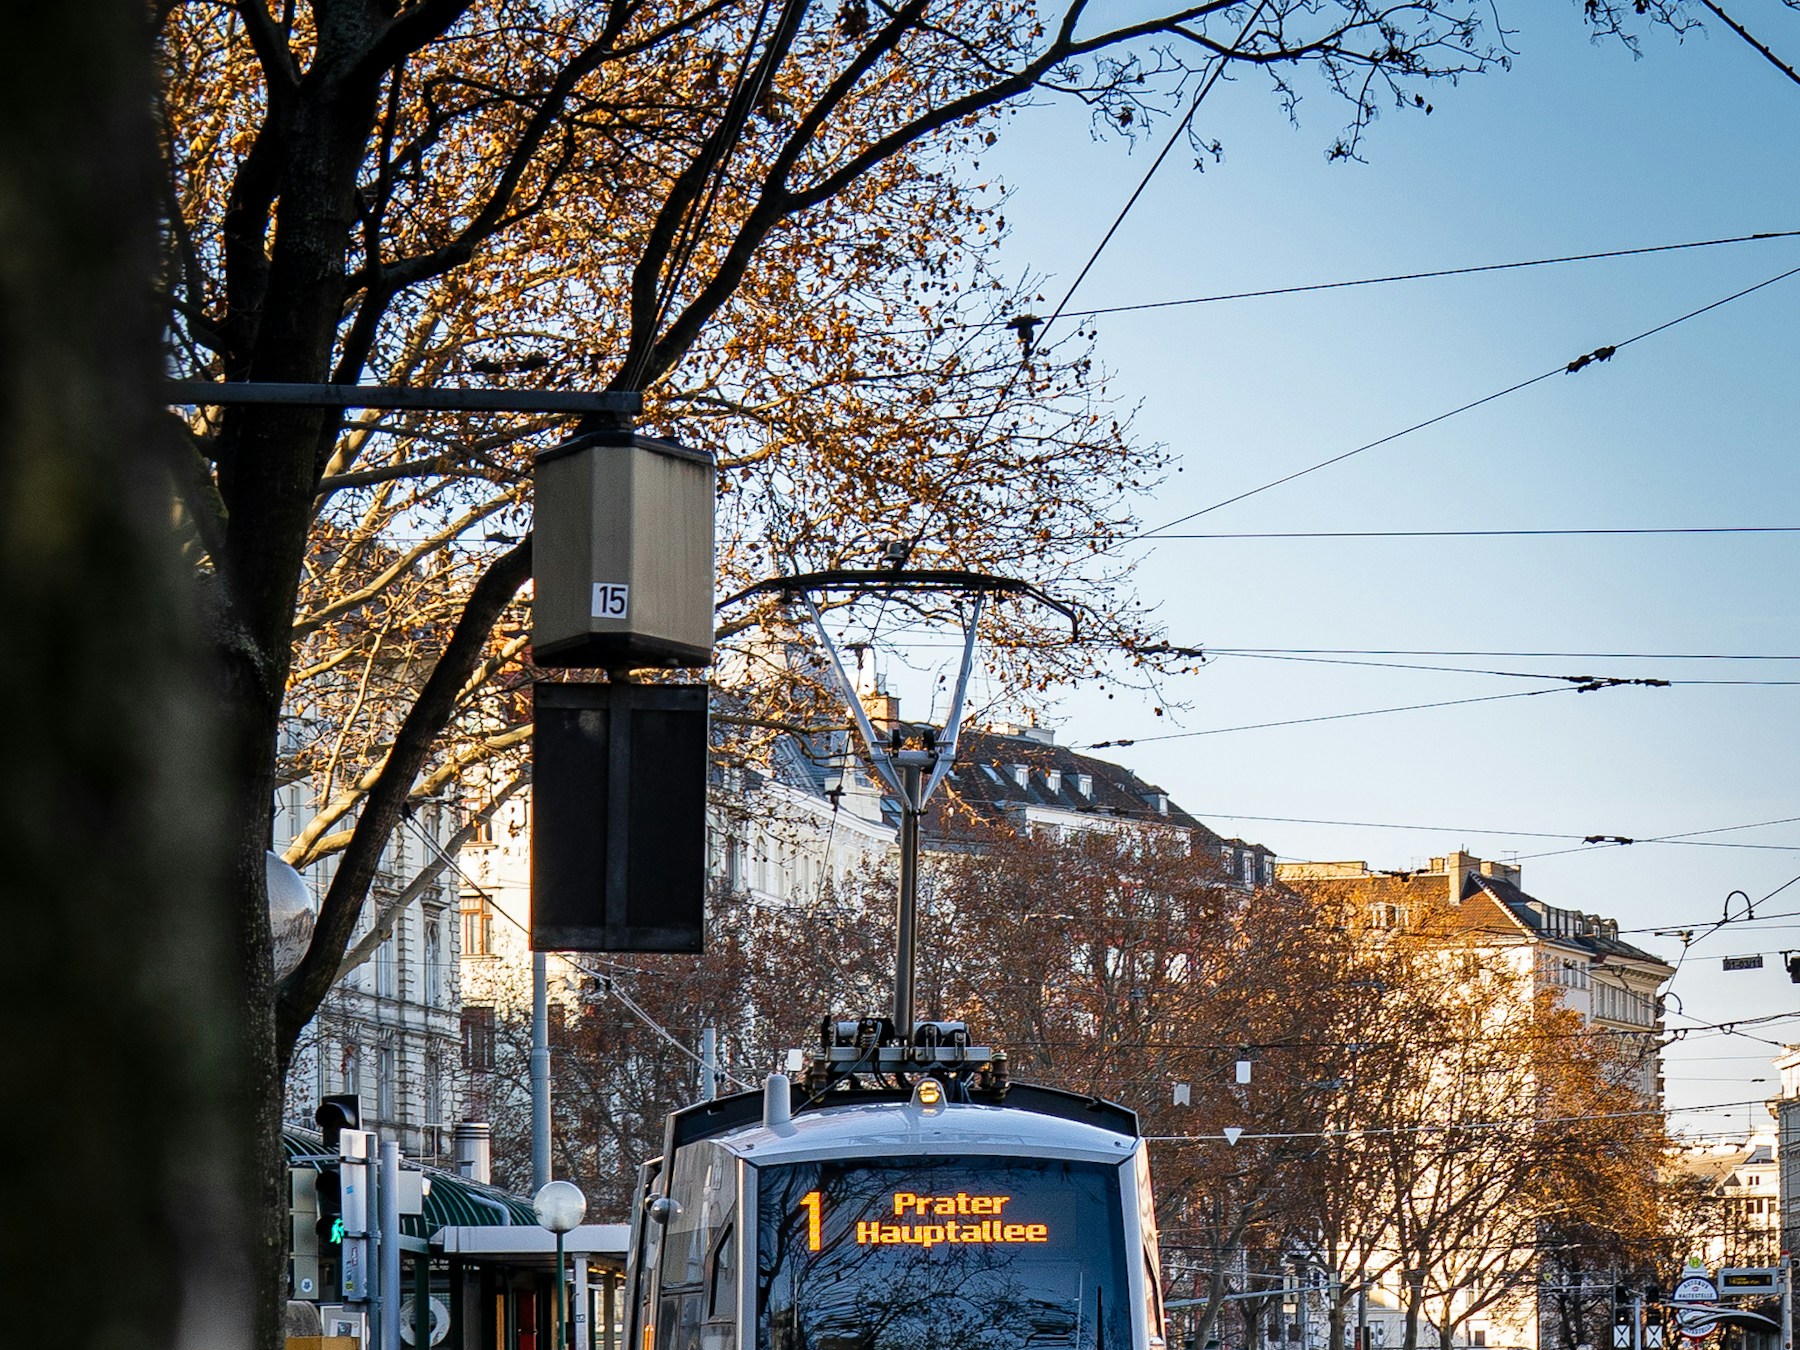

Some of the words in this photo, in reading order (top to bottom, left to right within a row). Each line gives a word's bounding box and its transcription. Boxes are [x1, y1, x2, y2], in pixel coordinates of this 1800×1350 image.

[599, 585, 626, 615] 15
[893, 1192, 1011, 1216] Prater
[799, 1190, 823, 1252] 1
[856, 1219, 1049, 1248] Hauptallee
[1683, 1280, 1710, 1290] AUTOBUS
